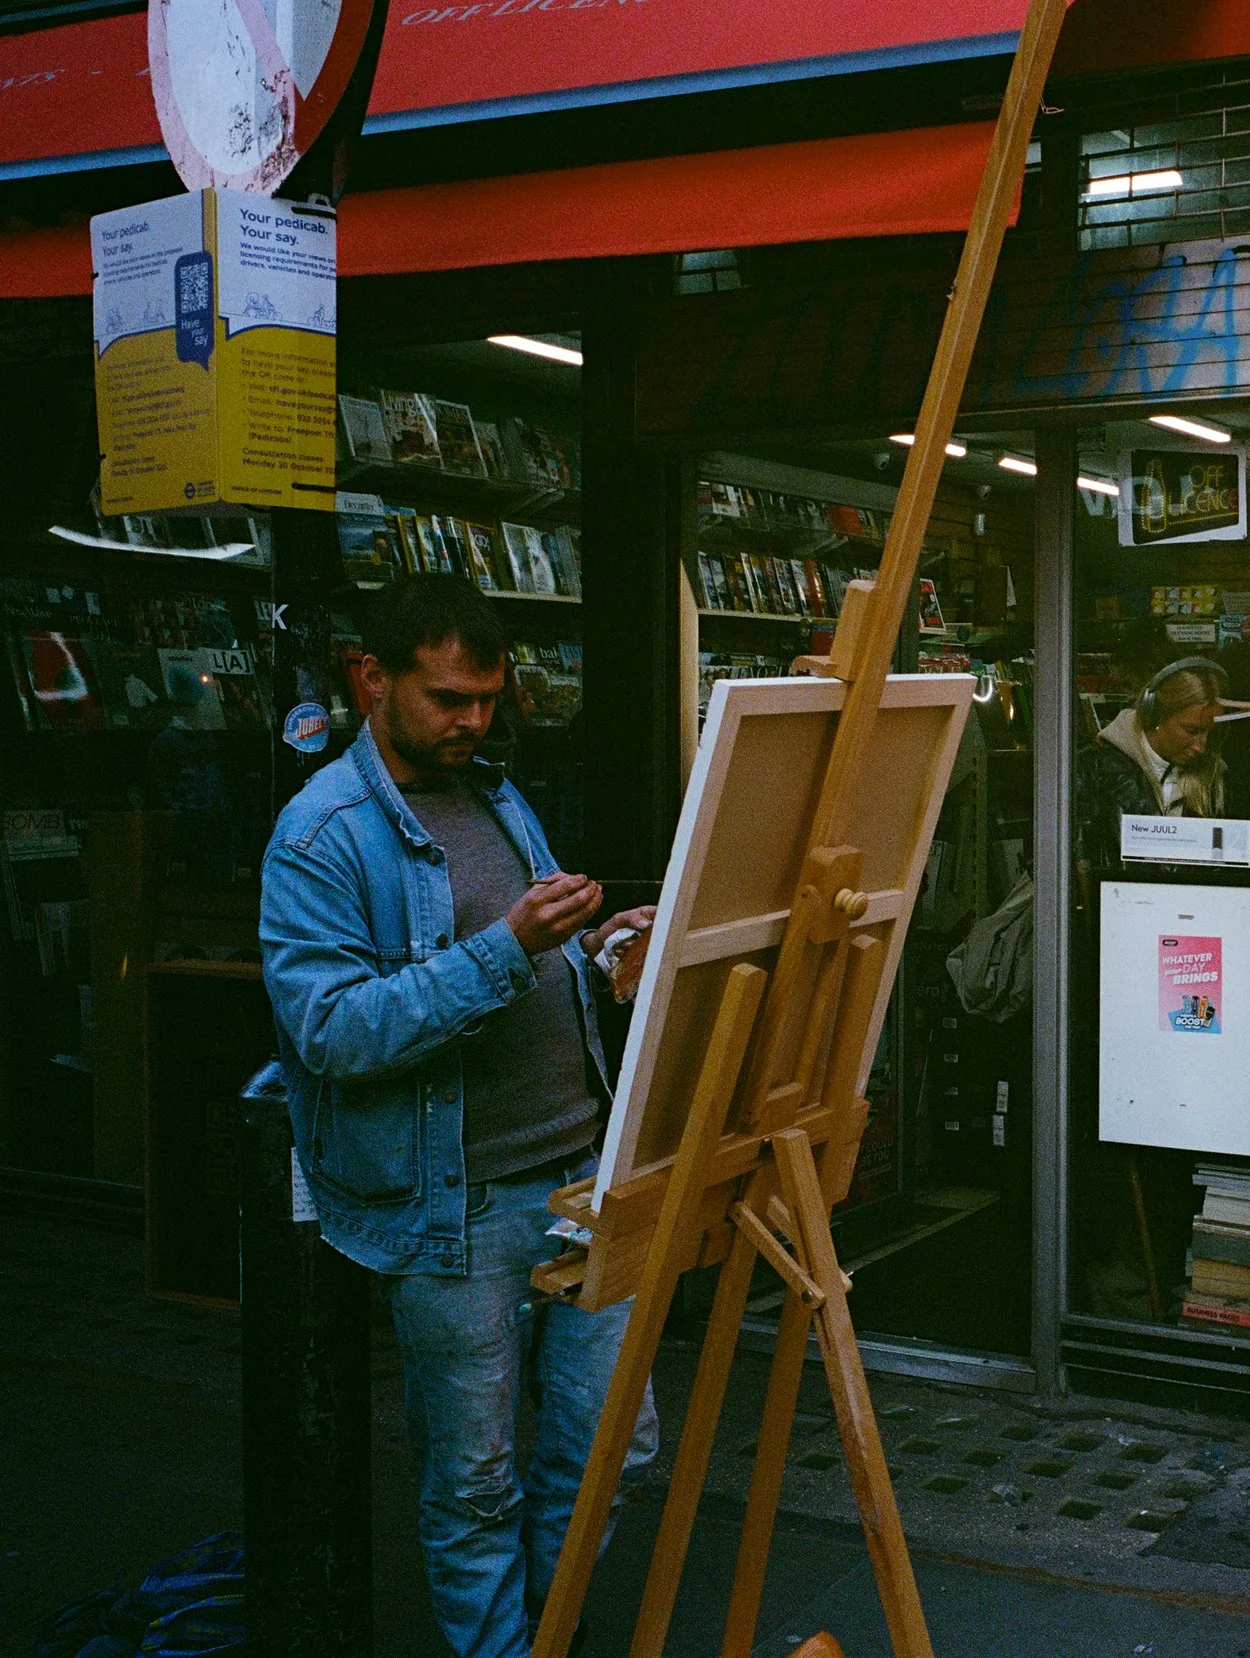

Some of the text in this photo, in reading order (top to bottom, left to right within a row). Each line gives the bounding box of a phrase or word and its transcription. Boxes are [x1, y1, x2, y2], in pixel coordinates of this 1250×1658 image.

[240, 209, 328, 234] Your pedicab.
[102, 230, 118, 241] Your
[240, 225, 299, 246] Your say.
[102, 246, 118, 257] Your
[254, 244, 276, 254] would
[278, 247, 290, 255] like
[291, 250, 307, 259] your
[240, 251, 271, 262] licensing
[272, 256, 318, 269] requirements
[318, 263, 328, 272] for
[240, 260, 266, 270] drivers,
[268, 264, 297, 274] vehicles
[298, 268, 310, 276] and
[182, 319, 200, 330] Have
[195, 336, 208, 346] say
[282, 353, 328, 366] information
[242, 458, 276, 469] Monday
[1131, 824, 1178, 834] New JUUL2
[1162, 952, 1213, 966] WHATEVER
[1183, 963, 1206, 974] DAY
[1173, 972, 1219, 986] BRINGS
[1176, 1018, 1204, 1026] BOOST
